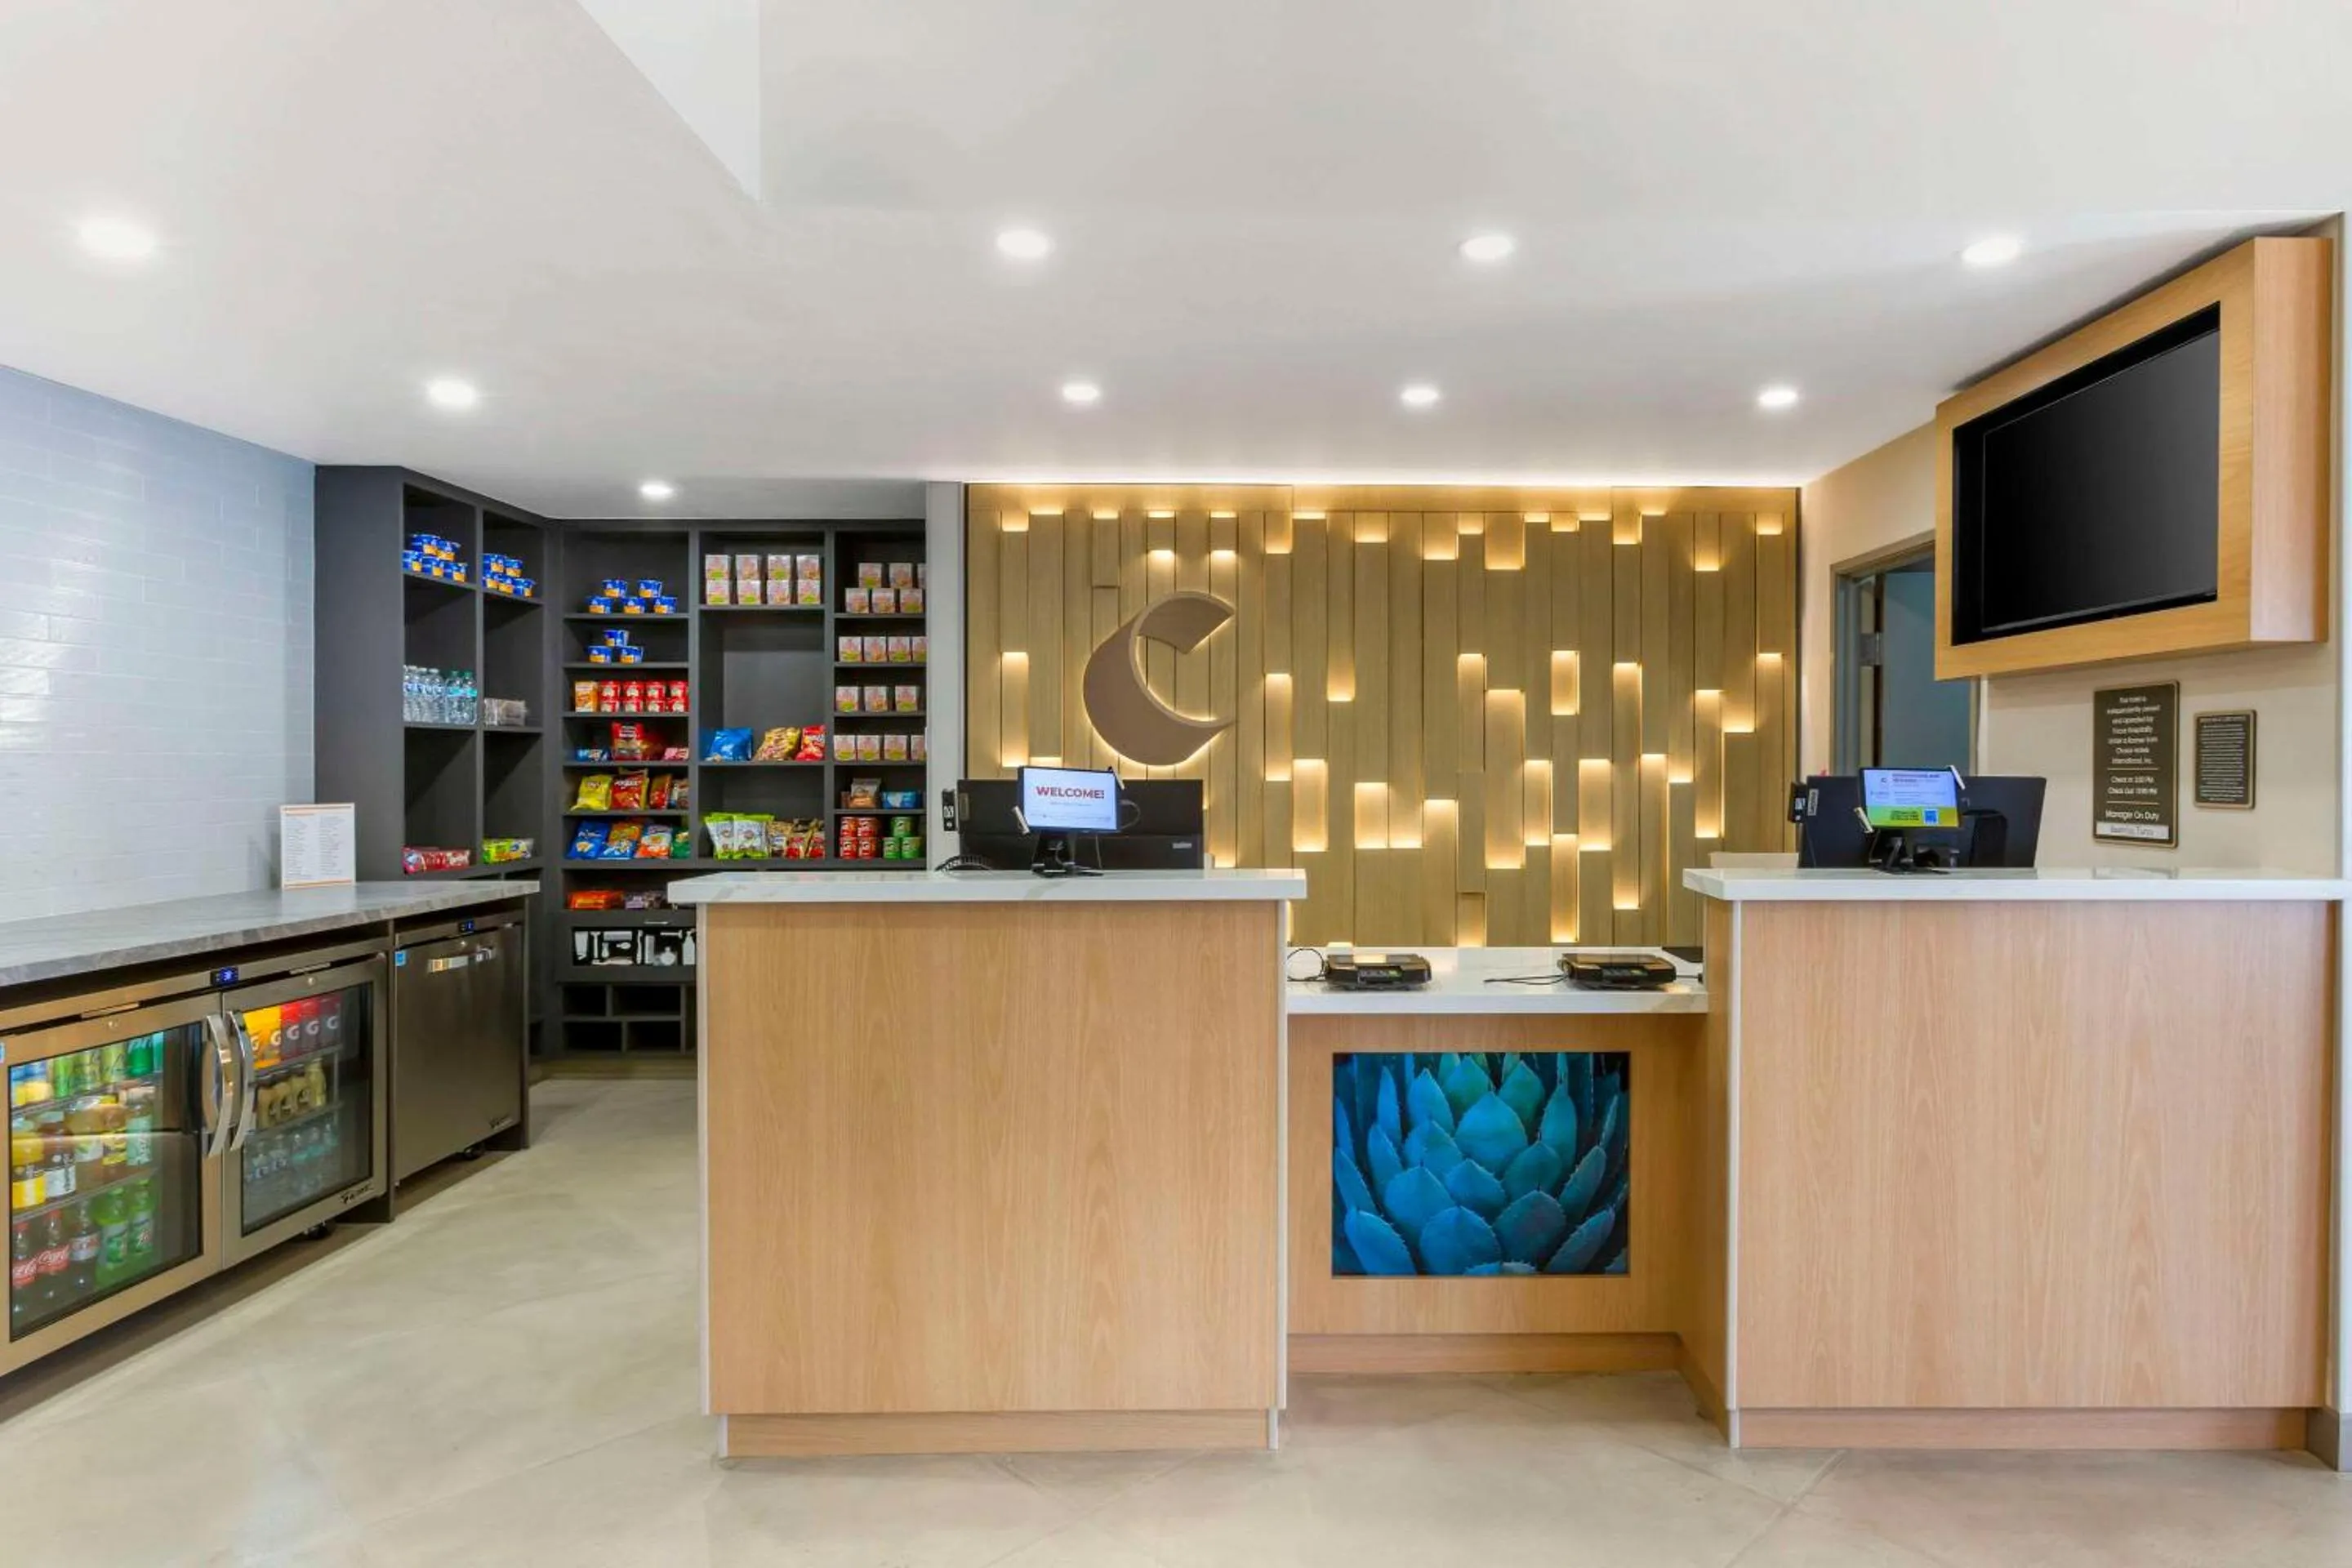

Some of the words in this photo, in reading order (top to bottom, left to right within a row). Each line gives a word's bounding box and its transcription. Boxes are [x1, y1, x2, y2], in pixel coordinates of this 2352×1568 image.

[1036, 786, 1105, 799] WELCOME!
[2145, 812, 2160, 822] Duty
[287, 1025, 300, 1040] G
[306, 1020, 319, 1035] G
